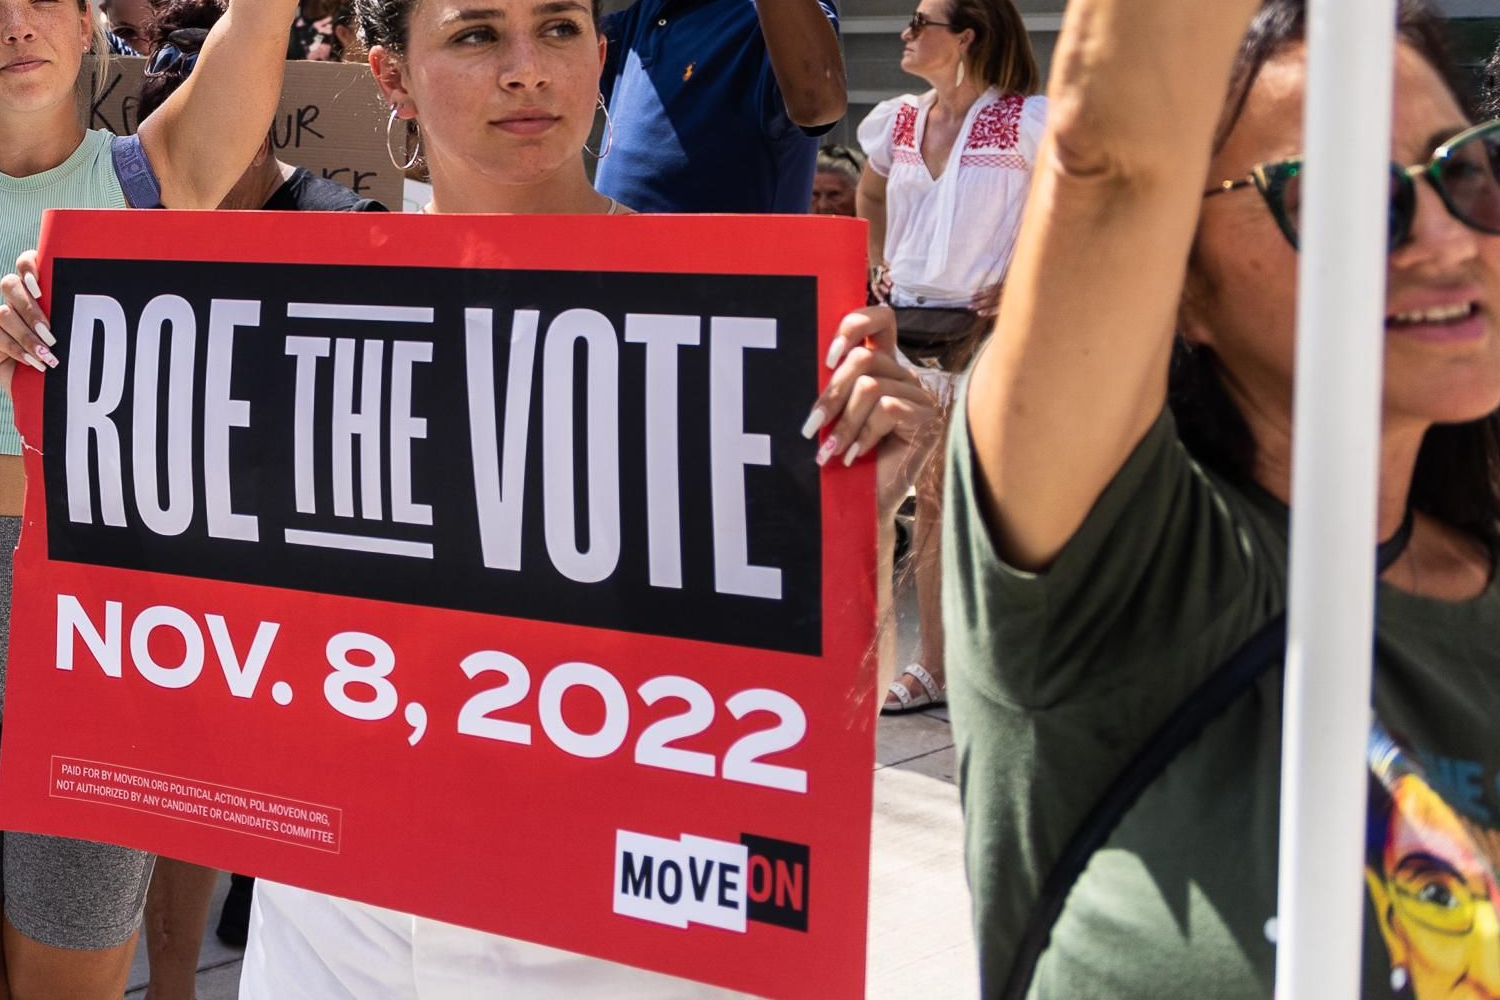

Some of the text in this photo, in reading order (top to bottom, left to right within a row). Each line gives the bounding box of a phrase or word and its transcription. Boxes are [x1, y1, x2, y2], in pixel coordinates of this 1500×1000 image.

[65, 292, 783, 600] ROE THE VOTE
[55, 593, 809, 795] NOV. 8, 2022
[56, 779, 336, 845] NOT AUTHORIZED BY ANY CANDIDATE OR CANDIDATE'S COMMITTEE.
[61, 764, 331, 828] PAID FOR BY MOVEON.ORG POLITICAL ACTION, POL.MOVEON.ORG,
[620, 848, 804, 914] MOVEON
